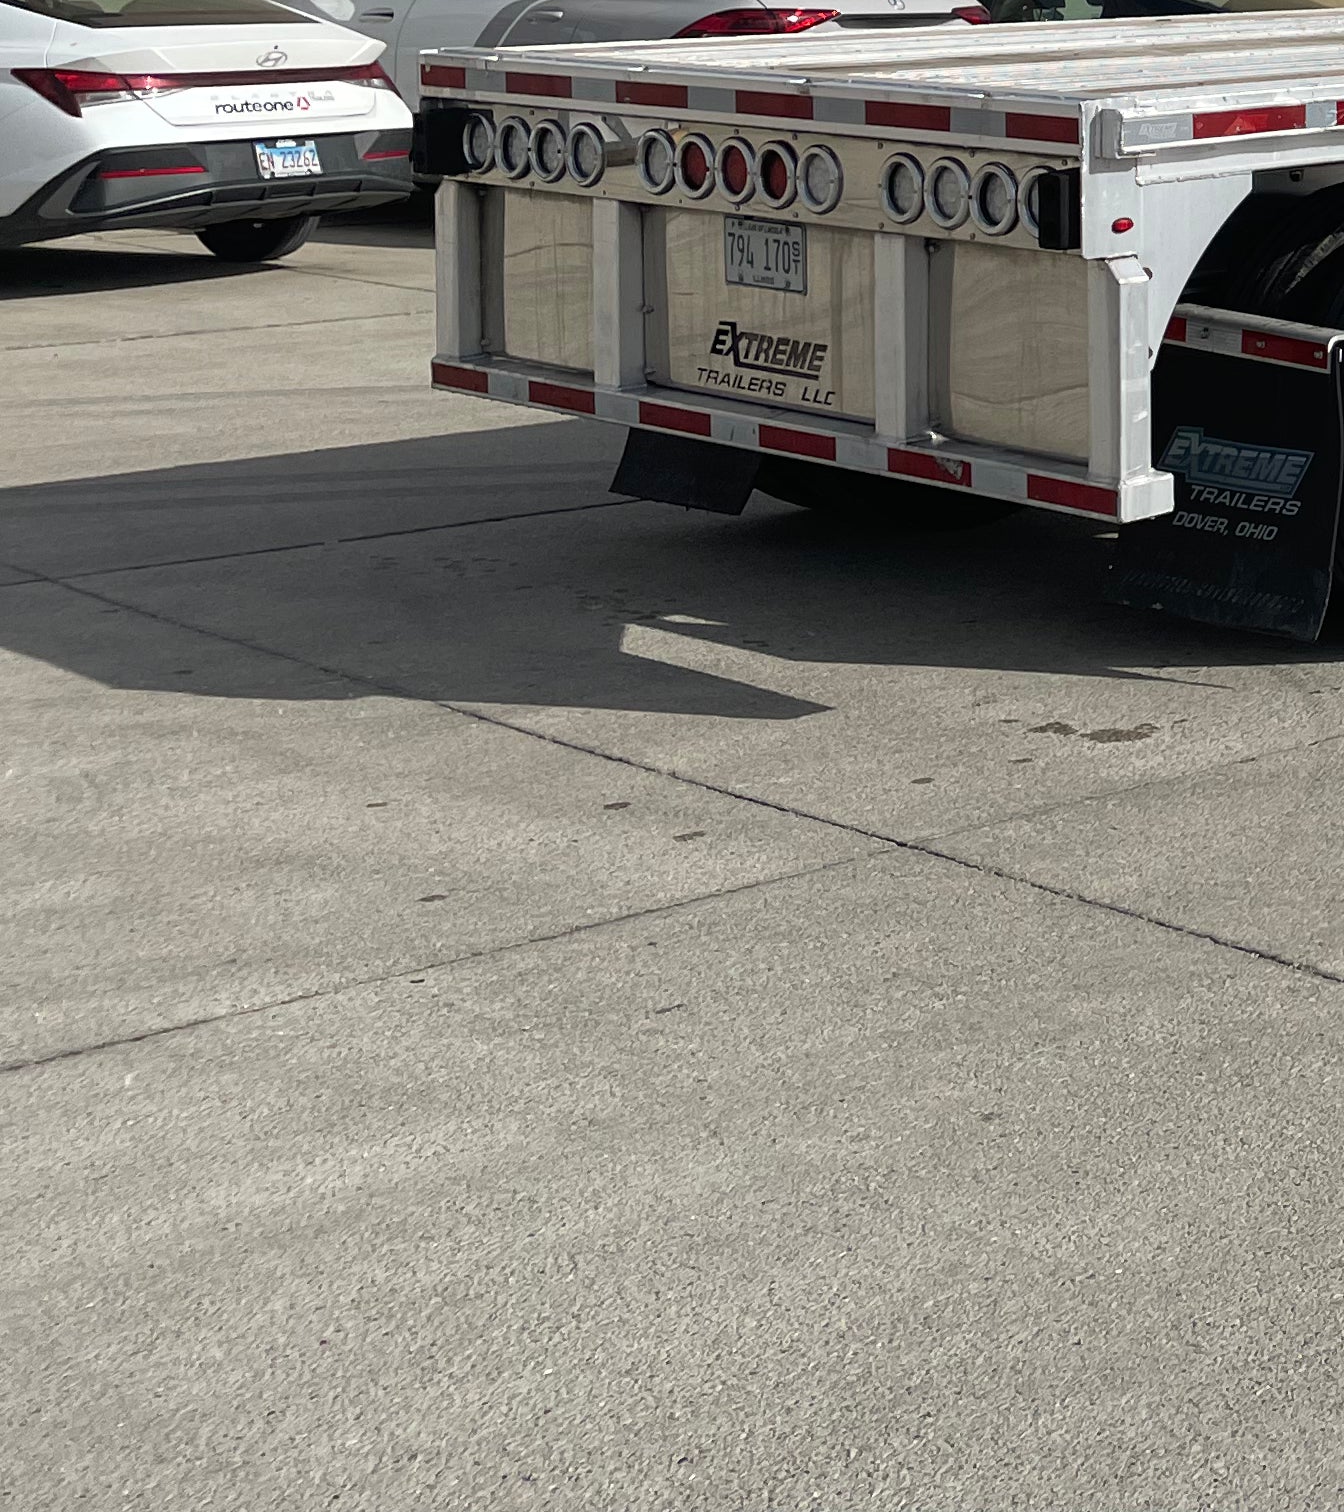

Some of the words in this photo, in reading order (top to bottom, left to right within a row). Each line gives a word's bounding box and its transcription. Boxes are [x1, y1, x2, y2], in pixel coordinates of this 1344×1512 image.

[215, 100, 294, 114] routeone
[727, 232, 754, 269] 794
[763, 238, 791, 275] 170
[710, 320, 829, 381] EXTREME
[697, 367, 787, 397] TRAILERS
[801, 386, 836, 406] LLC
[1165, 431, 1307, 493] EXTREME
[1189, 485, 1301, 516] TRAILERS
[1172, 511, 1229, 535] DOVER,
[1235, 521, 1279, 541] OHIO
